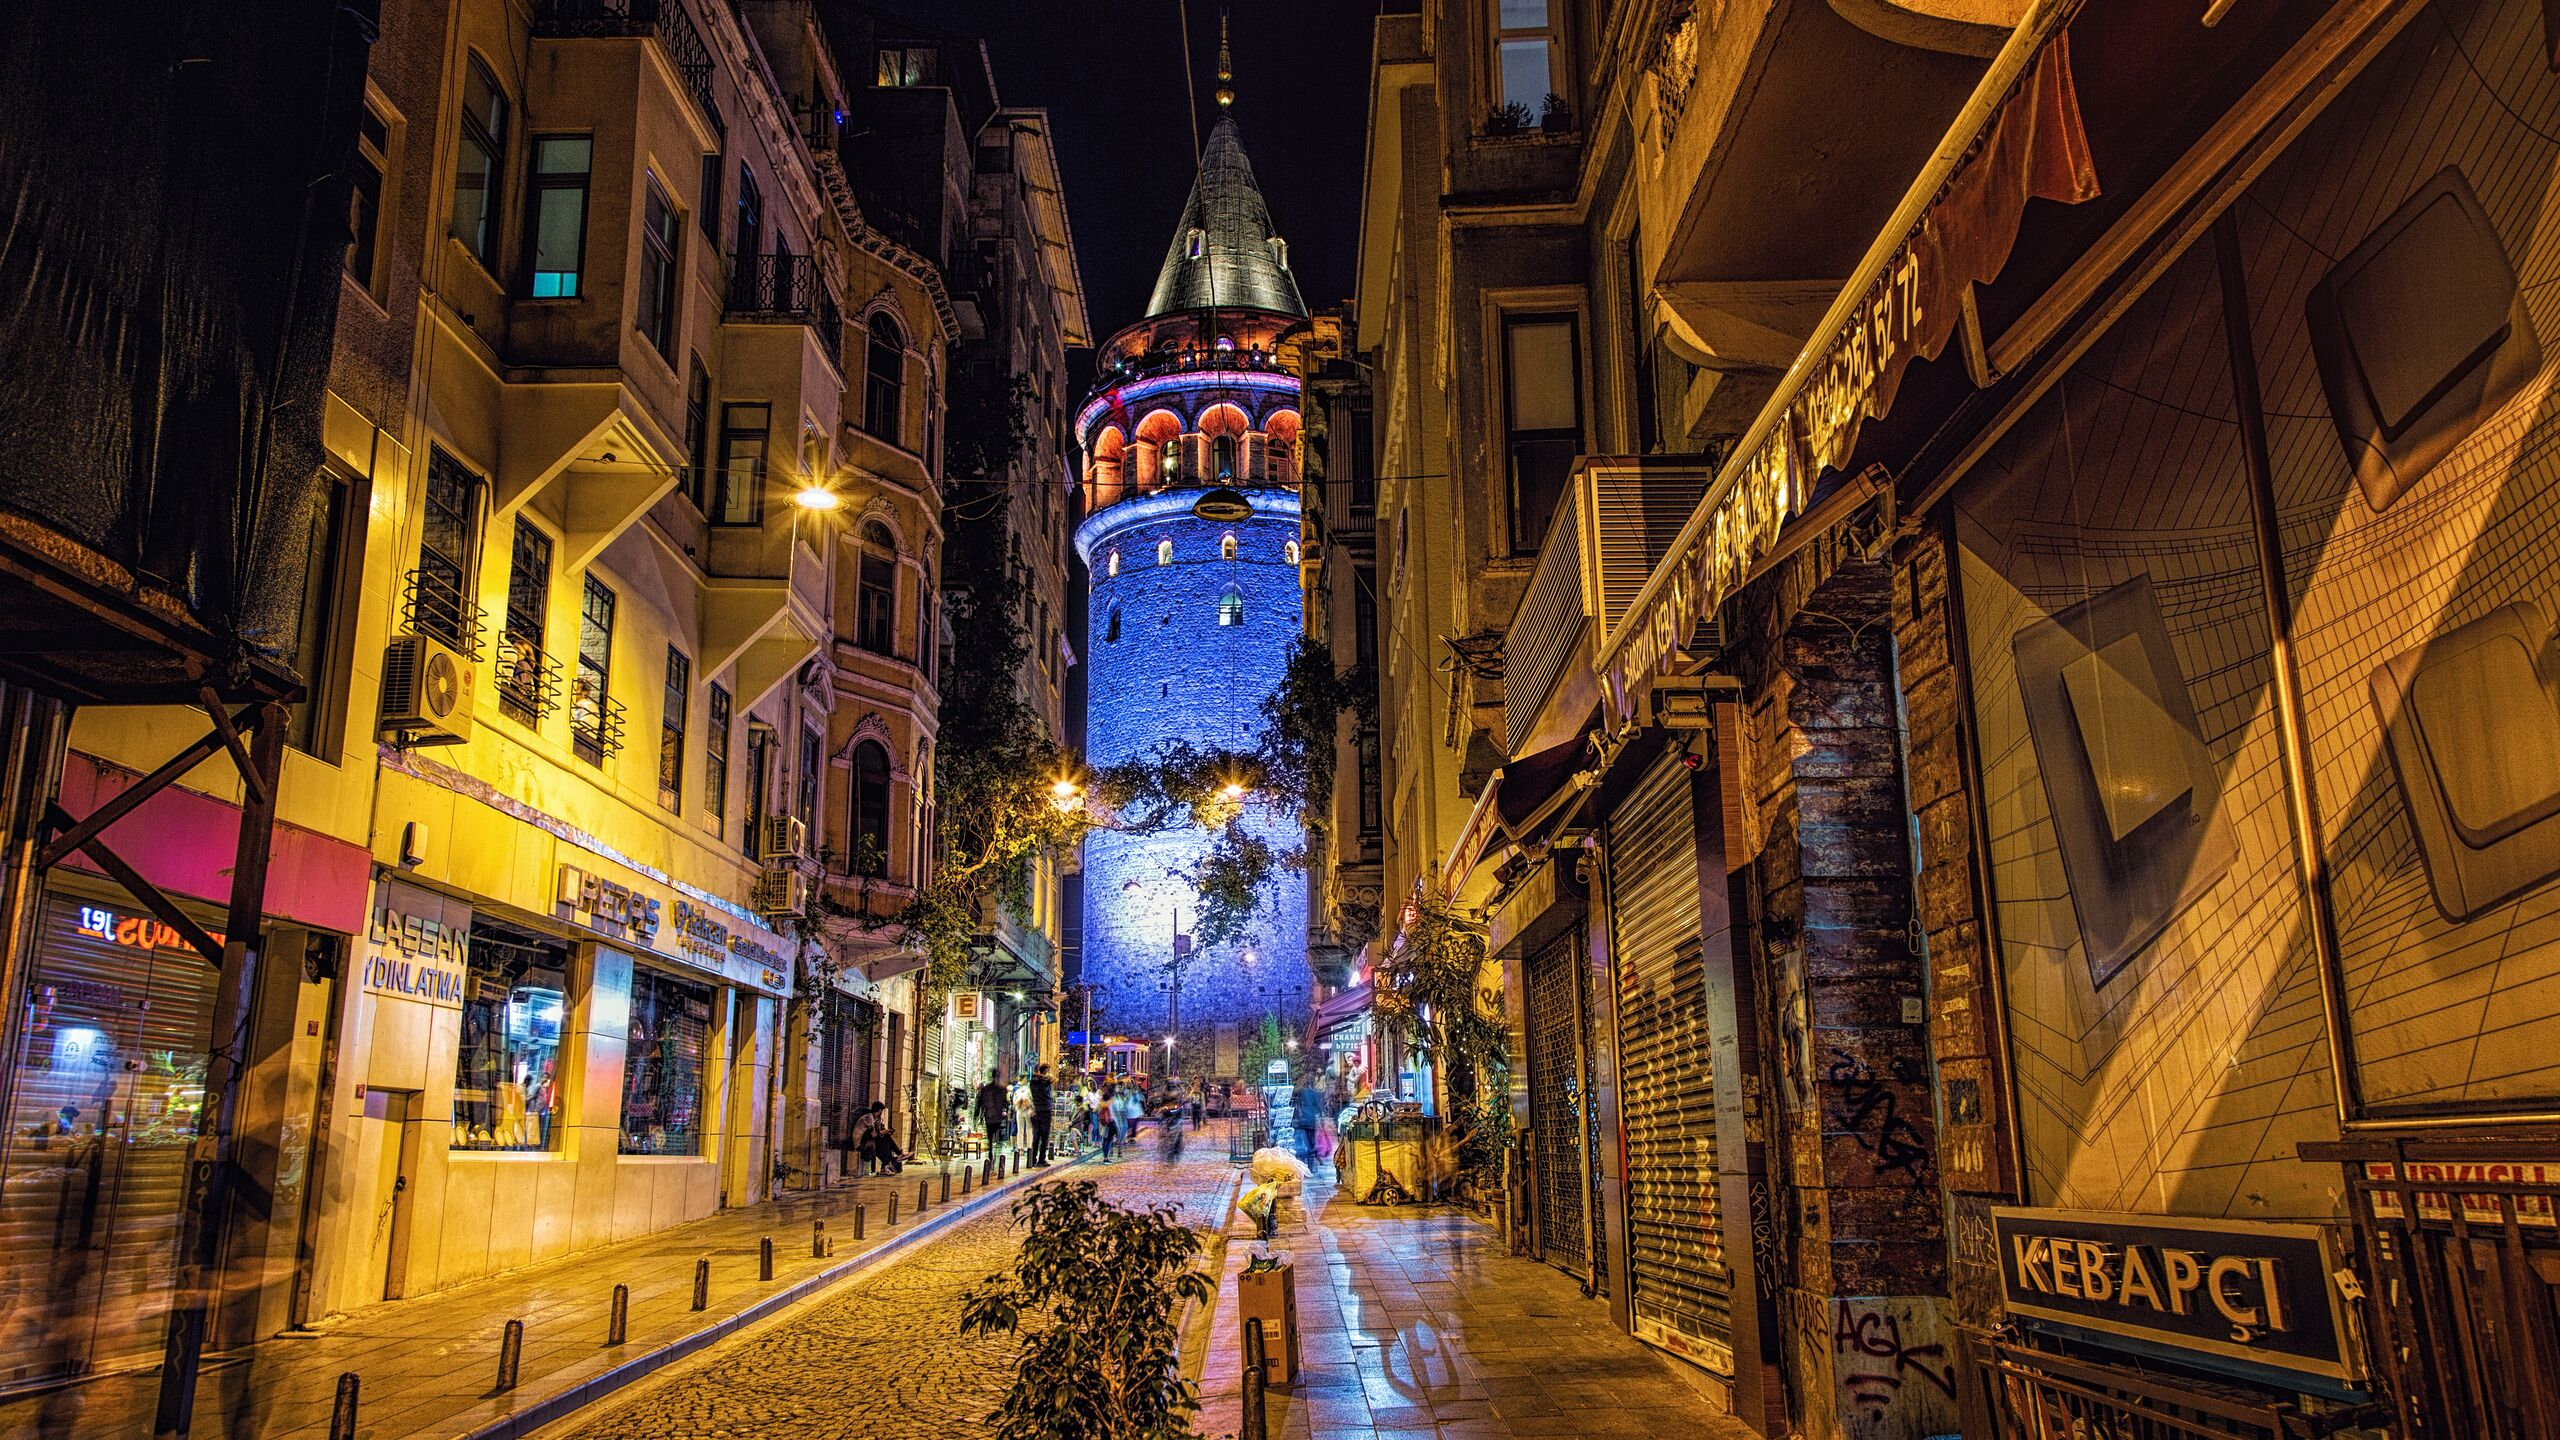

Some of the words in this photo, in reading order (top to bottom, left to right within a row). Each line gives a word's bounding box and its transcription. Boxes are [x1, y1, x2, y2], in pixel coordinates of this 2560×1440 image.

[1809, 364, 1846, 457] 0212
[1845, 322, 1874, 411] 252
[1874, 288, 1895, 372] 52
[1897, 253, 1922, 341] 72
[2012, 1233, 2288, 1342] KEBAPÇI
